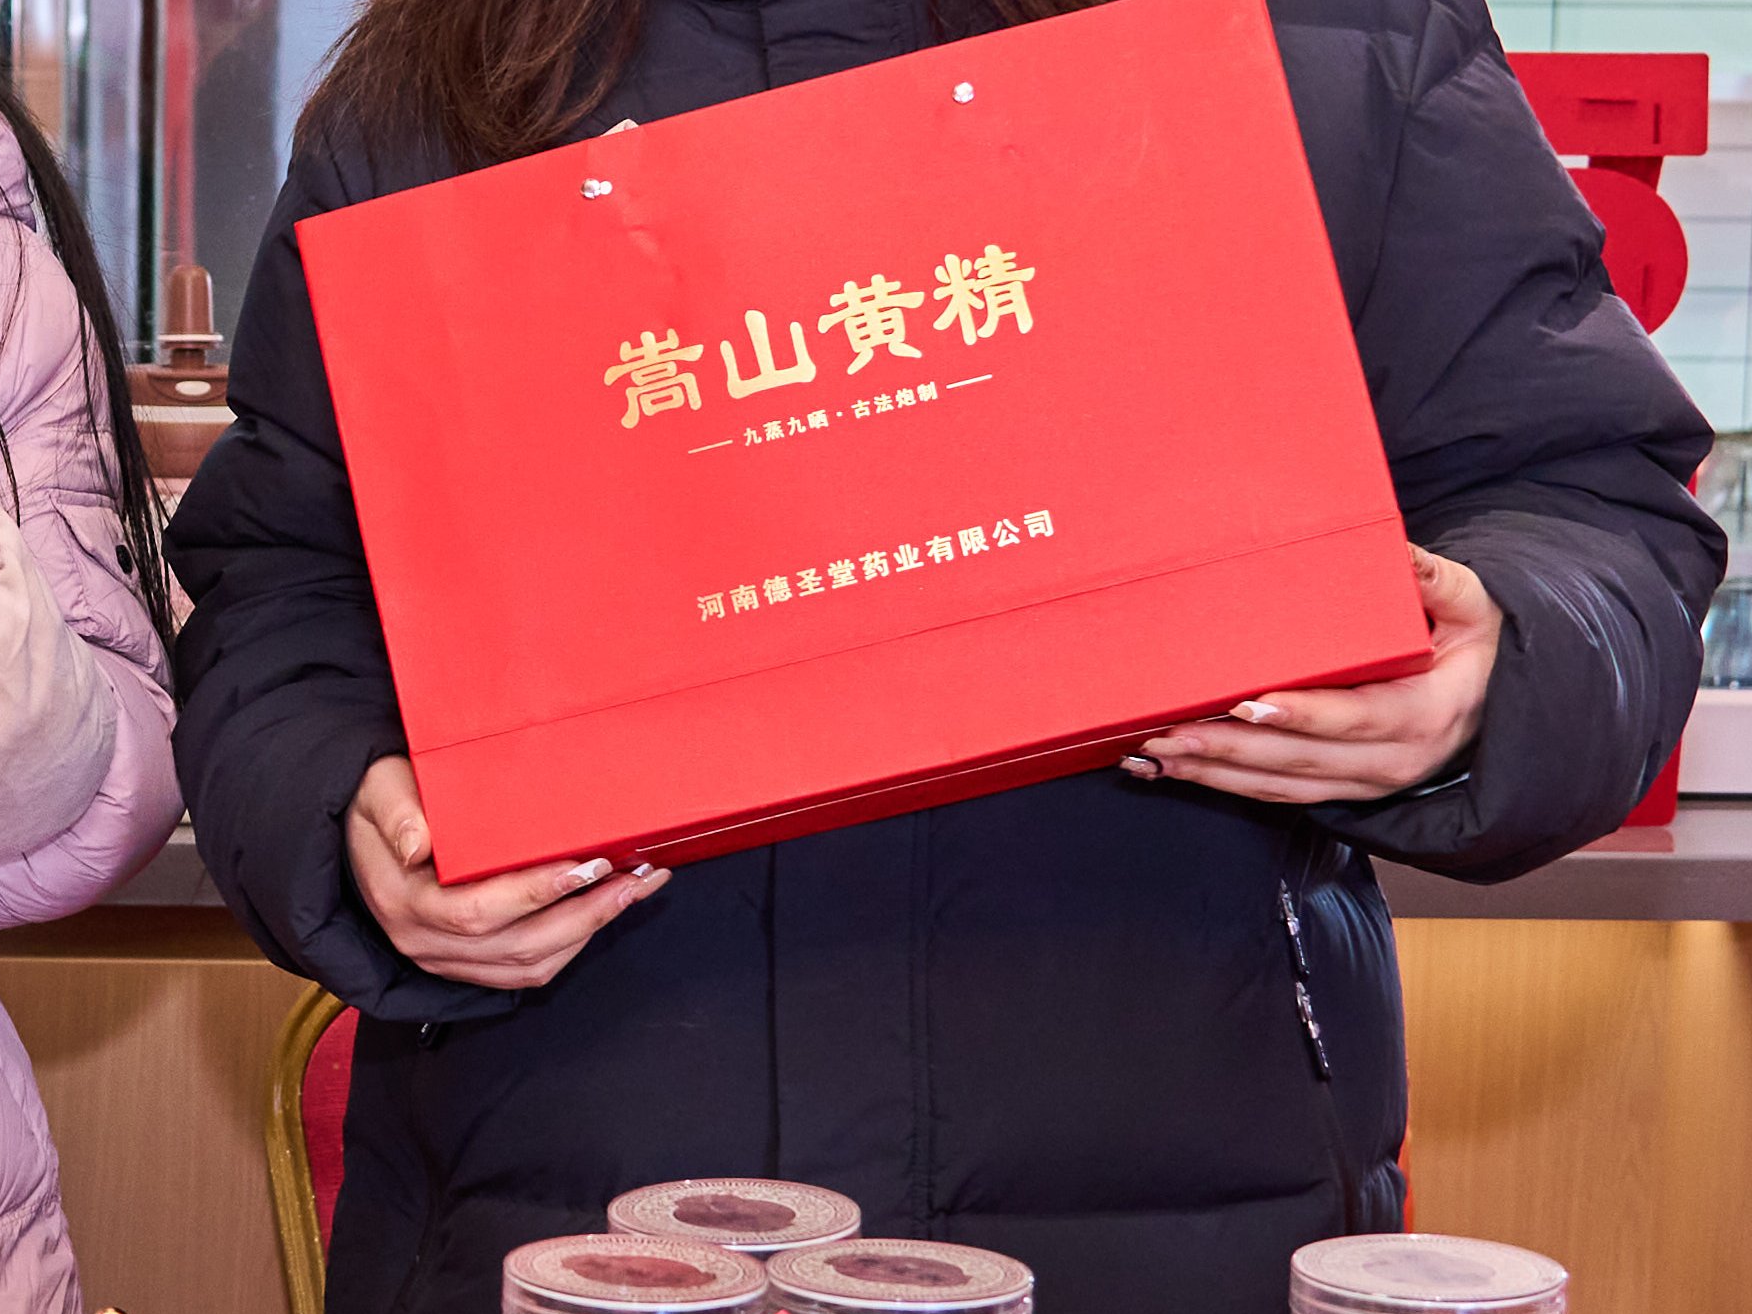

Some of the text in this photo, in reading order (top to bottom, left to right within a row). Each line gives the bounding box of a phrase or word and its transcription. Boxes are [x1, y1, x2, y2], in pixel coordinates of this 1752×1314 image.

[601, 241, 1037, 429] 嵩山黄精
[695, 508, 1057, 624] 河南德圣堂药业有限公司
